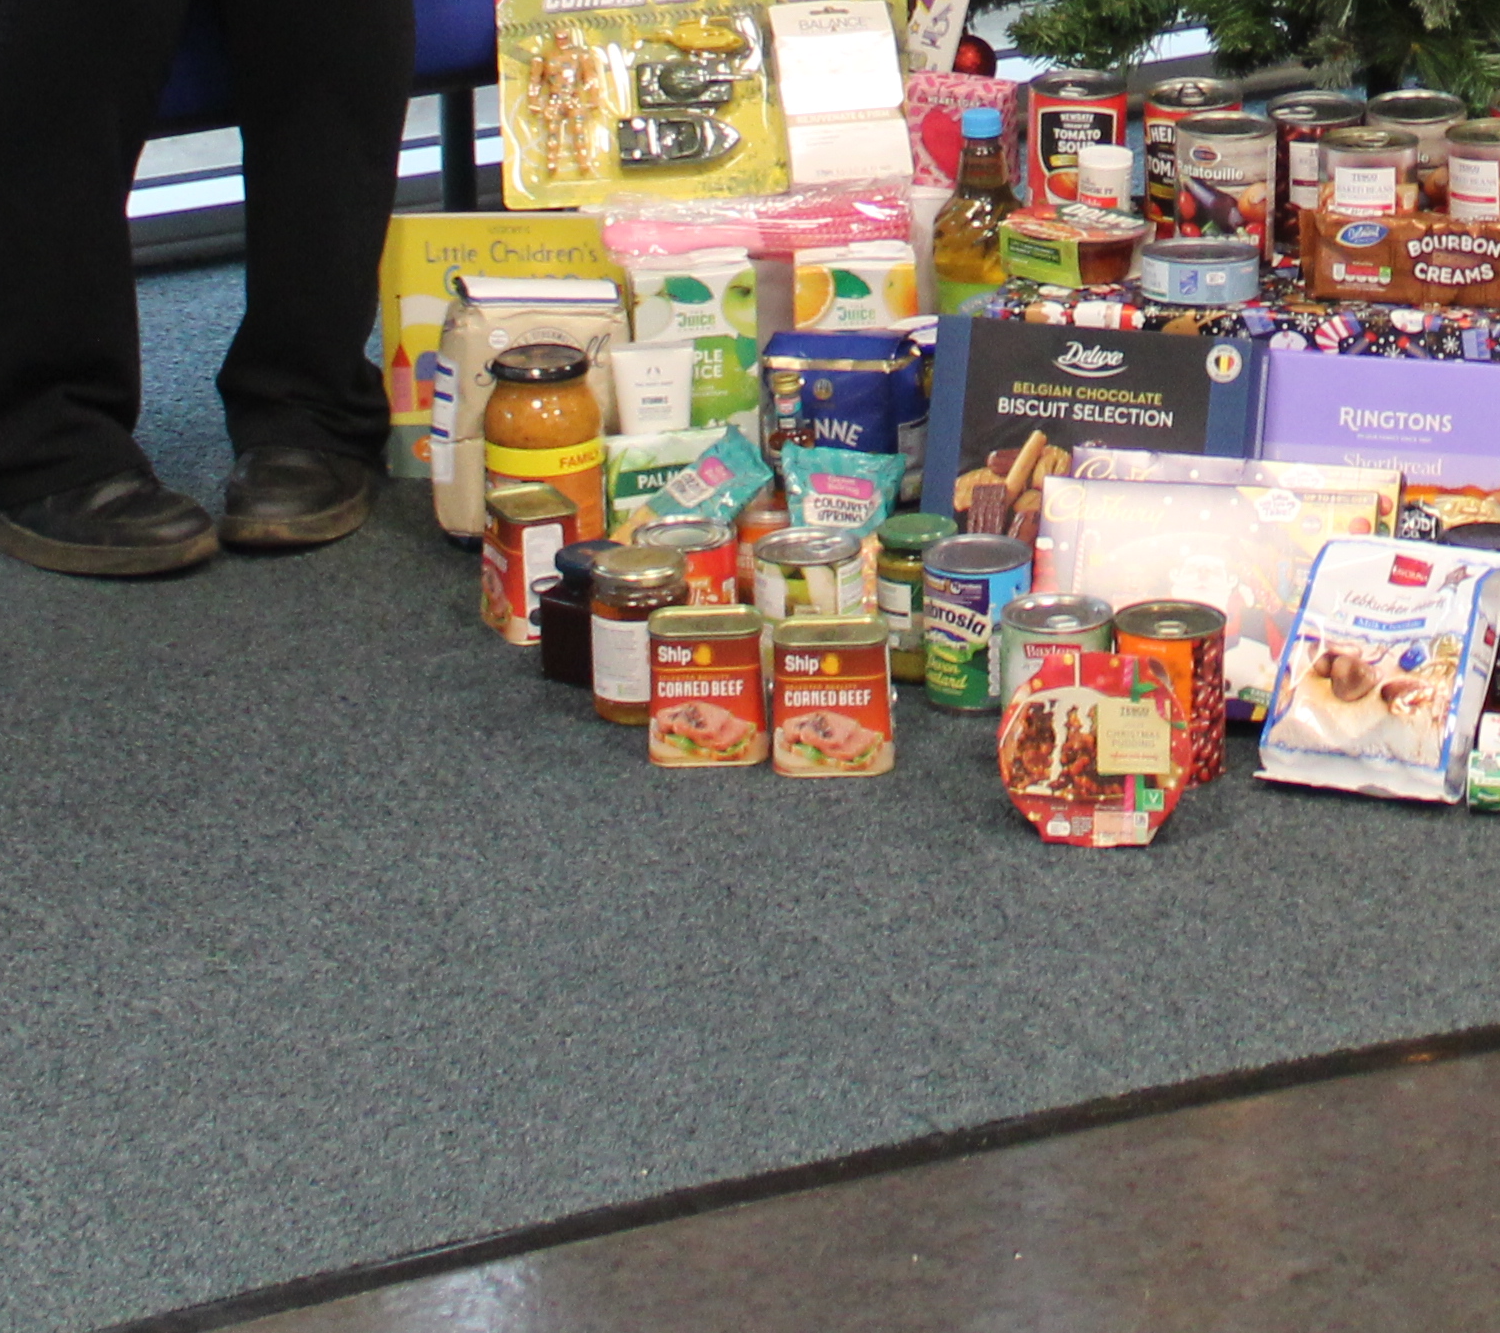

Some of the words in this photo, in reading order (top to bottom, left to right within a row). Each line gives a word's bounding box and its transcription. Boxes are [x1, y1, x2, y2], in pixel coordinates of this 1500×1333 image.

[799, 16, 866, 31] BALANCE
[1053, 127, 1101, 140] TOMATO
[1057, 140, 1098, 153] SOUP
[489, 240, 599, 264] Children's
[1413, 262, 1495, 285] CREAMS
[693, 349, 724, 364] PLE
[1056, 341, 1125, 367] Deluxe
[695, 364, 724, 380] ICE
[1013, 382, 1073, 398] BELGIAN
[1075, 386, 1163, 407] CHOCOLATE
[997, 397, 1070, 420] BISCUIT
[1072, 404, 1174, 429] SELECTION
[1338, 406, 1454, 433] RINGTONS
[814, 417, 864, 447] NNE
[1343, 452, 1443, 477] Shortbread
[1044, 484, 1167, 524] Cadbury
[929, 601, 987, 637] brosia
[657, 645, 692, 666] Ship
[784, 654, 820, 675] Ship
[658, 681, 709, 698] CORNED
[711, 679, 744, 696] BEEF
[784, 690, 837, 707] CORNED
[838, 689, 872, 706] BEEF
